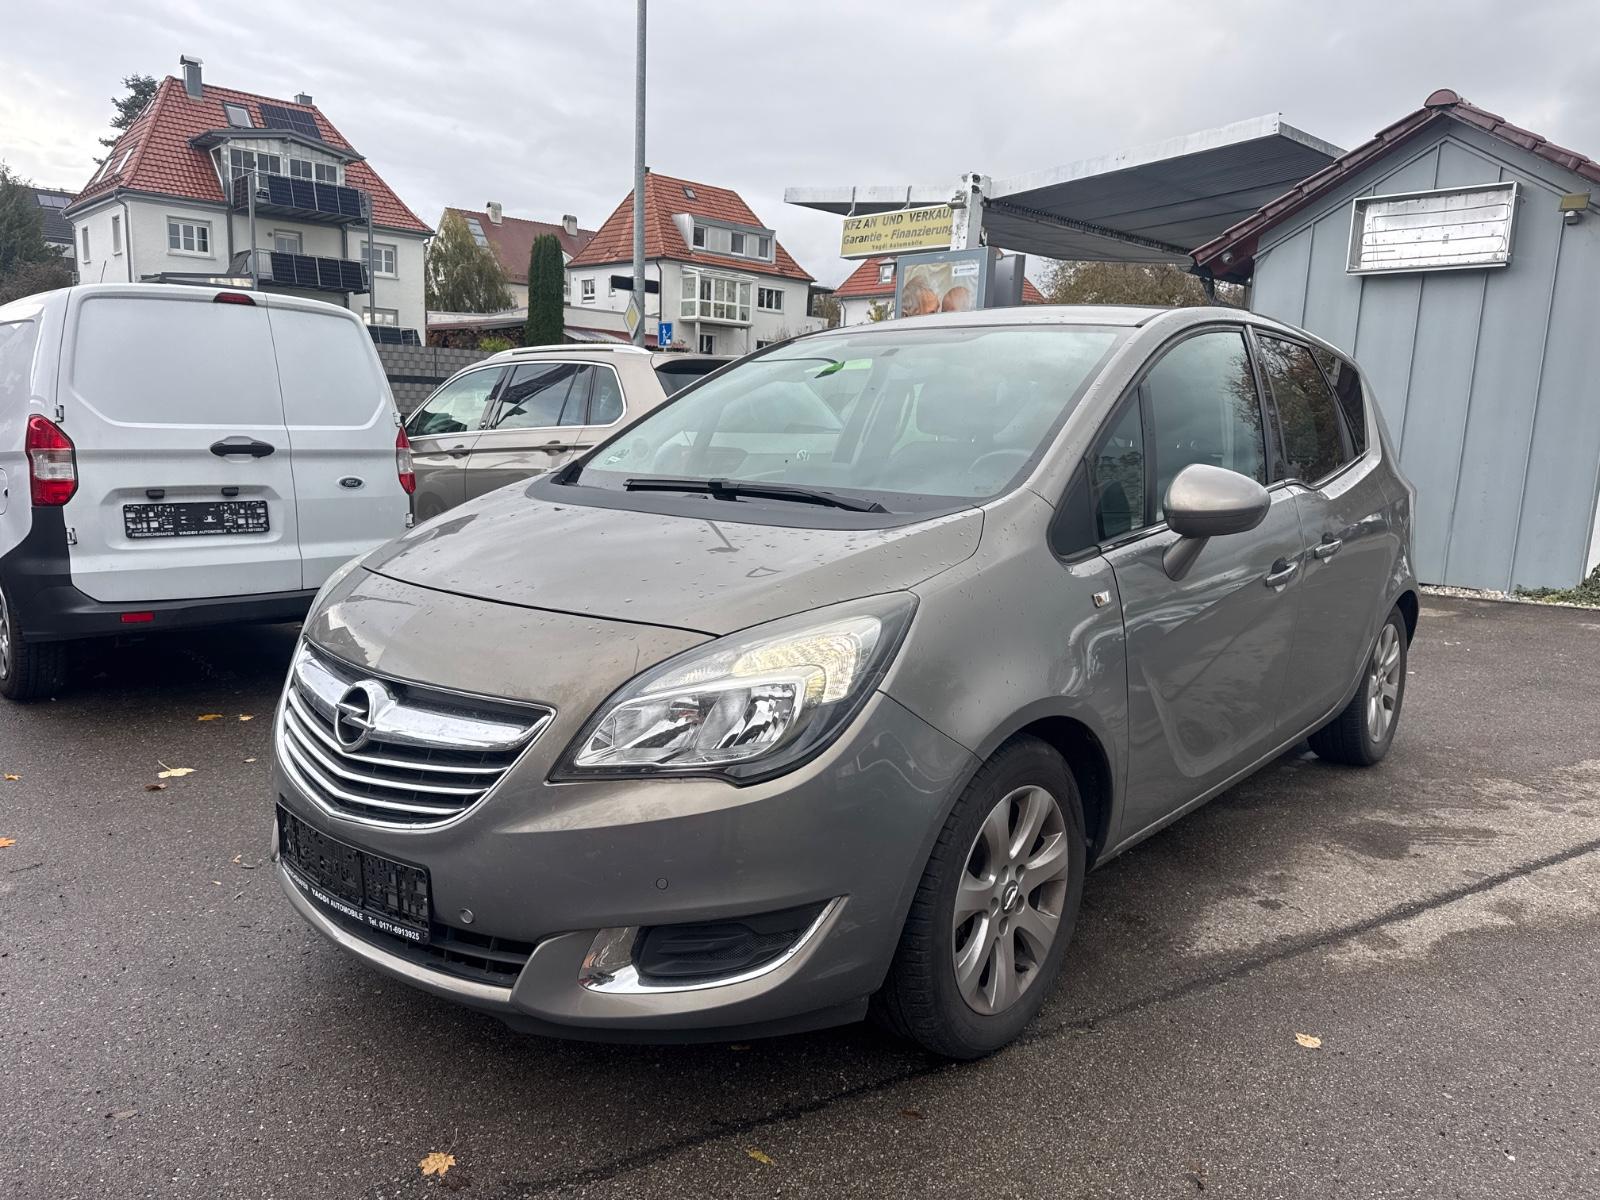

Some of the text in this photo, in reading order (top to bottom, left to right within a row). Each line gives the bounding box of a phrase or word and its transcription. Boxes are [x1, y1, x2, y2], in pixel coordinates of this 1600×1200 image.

[844, 219, 862, 231] KFZ
[863, 218, 877, 229] AN
[882, 214, 903, 226] UND
[844, 231, 882, 245] Garantie
[891, 224, 954, 240] Finanzierung
[889, 240, 923, 248] Automobile
[330, 900, 363, 921] AUTOMOBILE
[368, 916, 379, 927] Tel.
[379, 920, 420, 941] 0171-6913925
